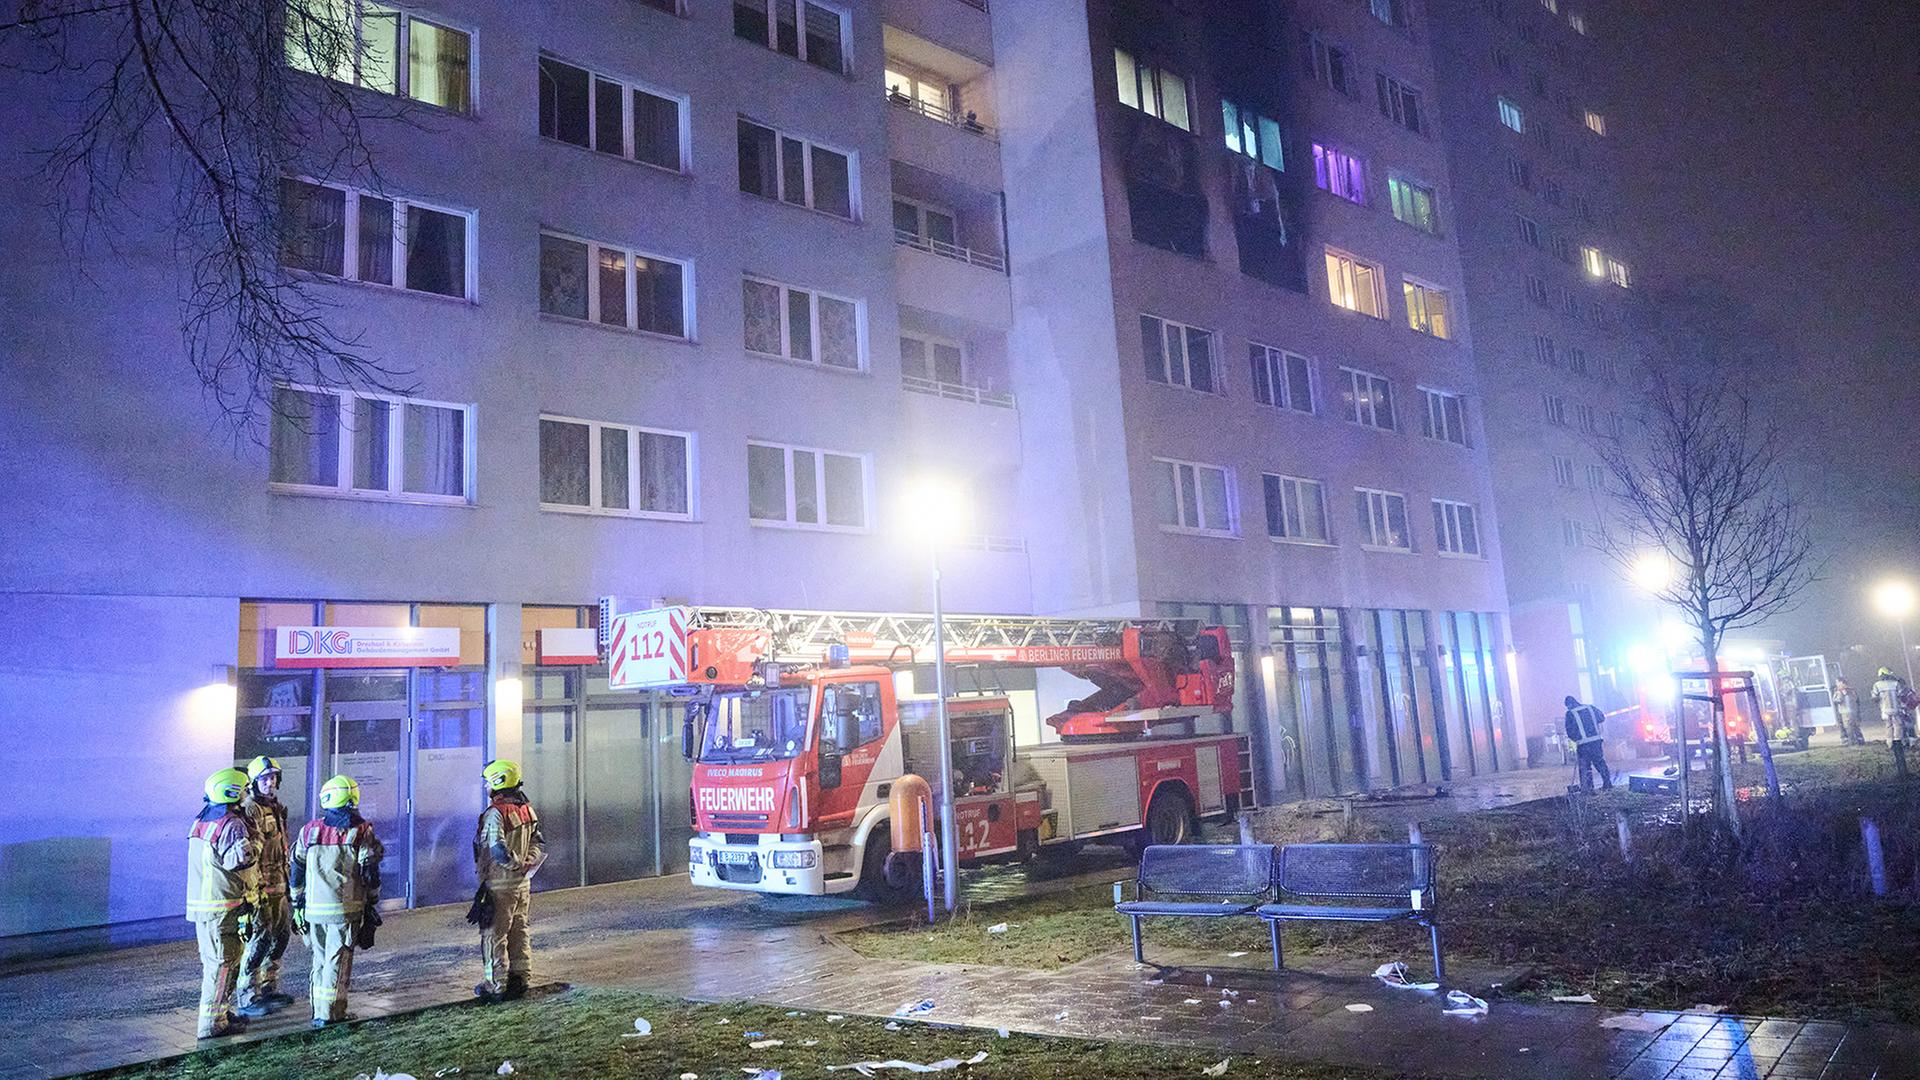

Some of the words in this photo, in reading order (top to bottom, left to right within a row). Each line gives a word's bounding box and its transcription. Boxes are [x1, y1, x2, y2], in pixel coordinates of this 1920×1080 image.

[289, 630, 352, 654] DKG
[631, 631, 665, 661] 112
[1028, 648, 1070, 662] BERLINER
[1072, 647, 1121, 660] FEUERWEHR
[707, 768, 727, 777] IVECO
[728, 768, 764, 777] MAGIRUS
[699, 787, 775, 811] FEUERWEHR
